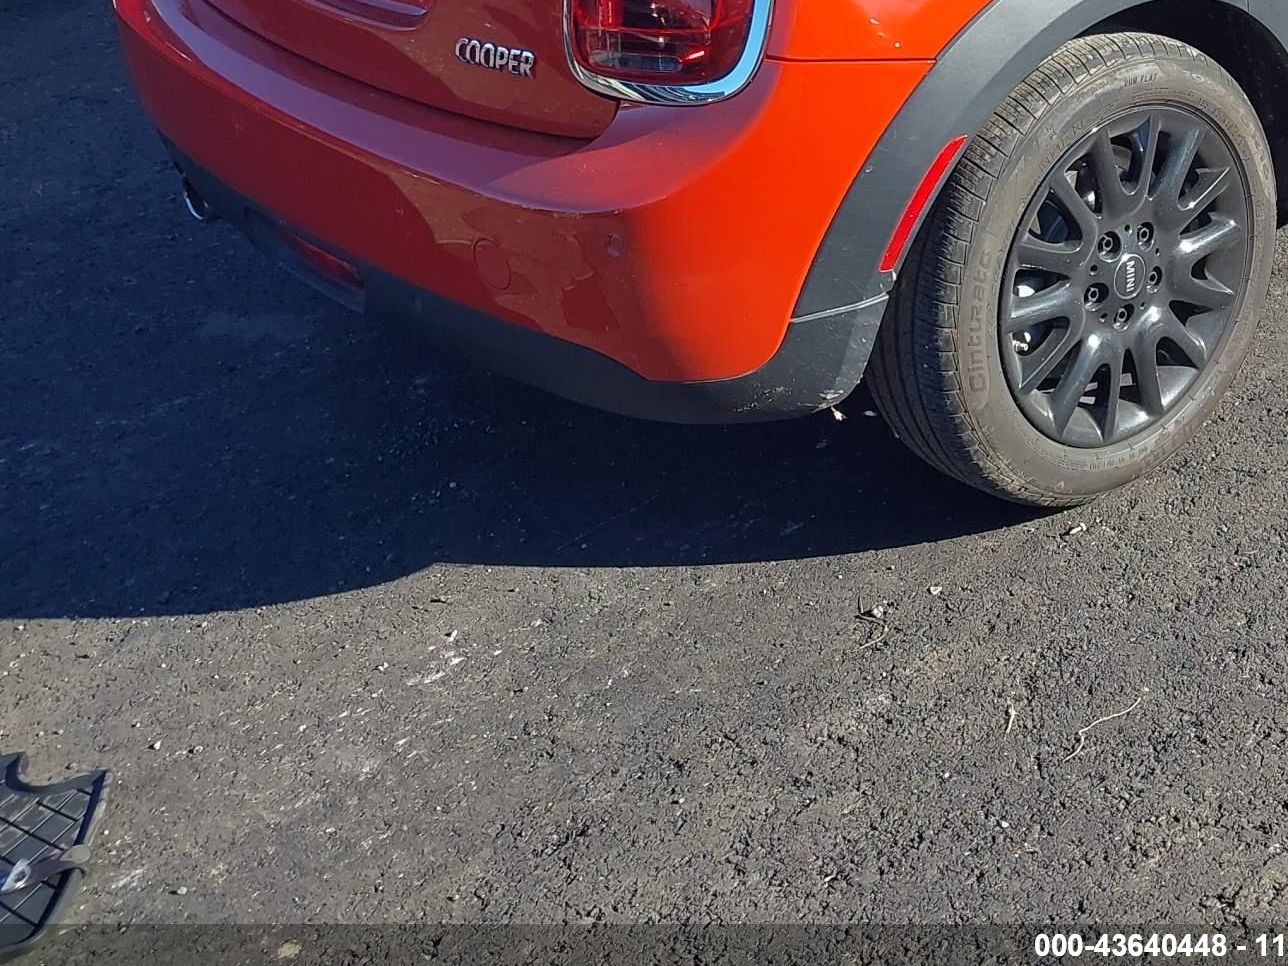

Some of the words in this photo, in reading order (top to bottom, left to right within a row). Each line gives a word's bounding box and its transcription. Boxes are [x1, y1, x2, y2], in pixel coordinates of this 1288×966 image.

[455, 37, 535, 79] COOPER
[1126, 260, 1135, 293] MINI
[968, 248, 993, 393] Cinturato
